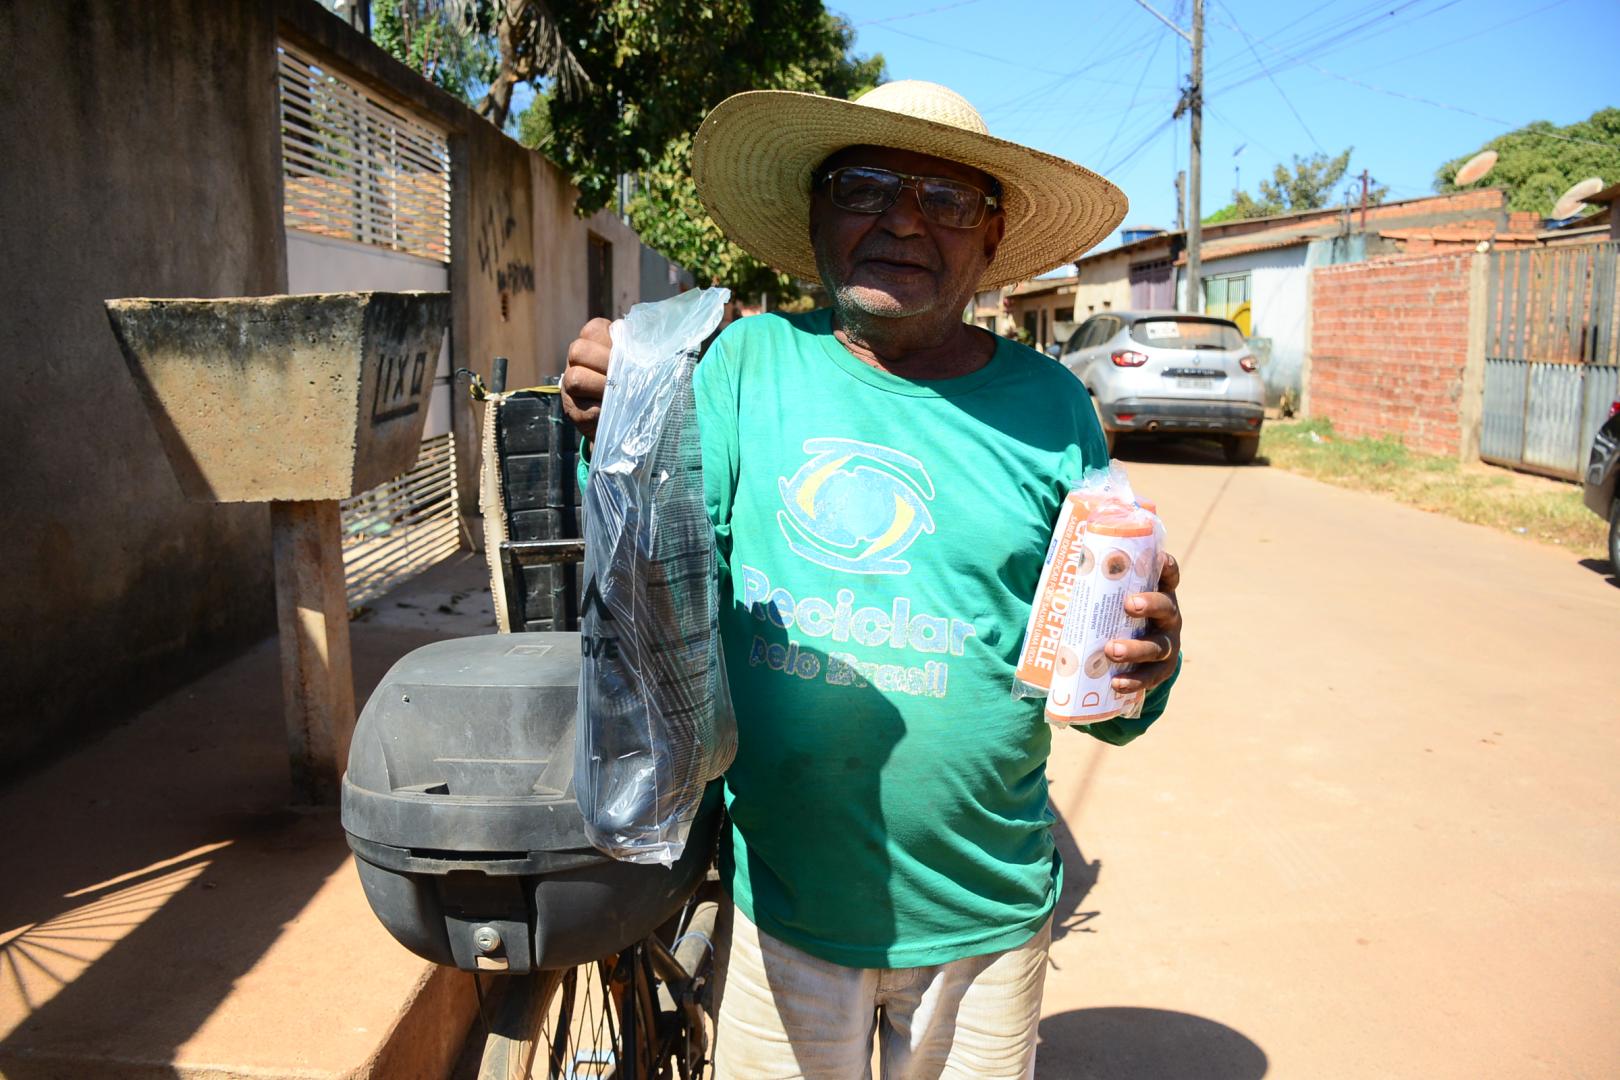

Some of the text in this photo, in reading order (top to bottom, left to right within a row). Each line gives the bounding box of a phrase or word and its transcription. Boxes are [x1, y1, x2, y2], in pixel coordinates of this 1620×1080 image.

[372, 351, 427, 427] LIXO
[742, 564, 976, 656] Reciclar
[1047, 595, 1068, 624] DE
[1034, 623, 1062, 671] PELE
[1082, 692, 1100, 708] D
